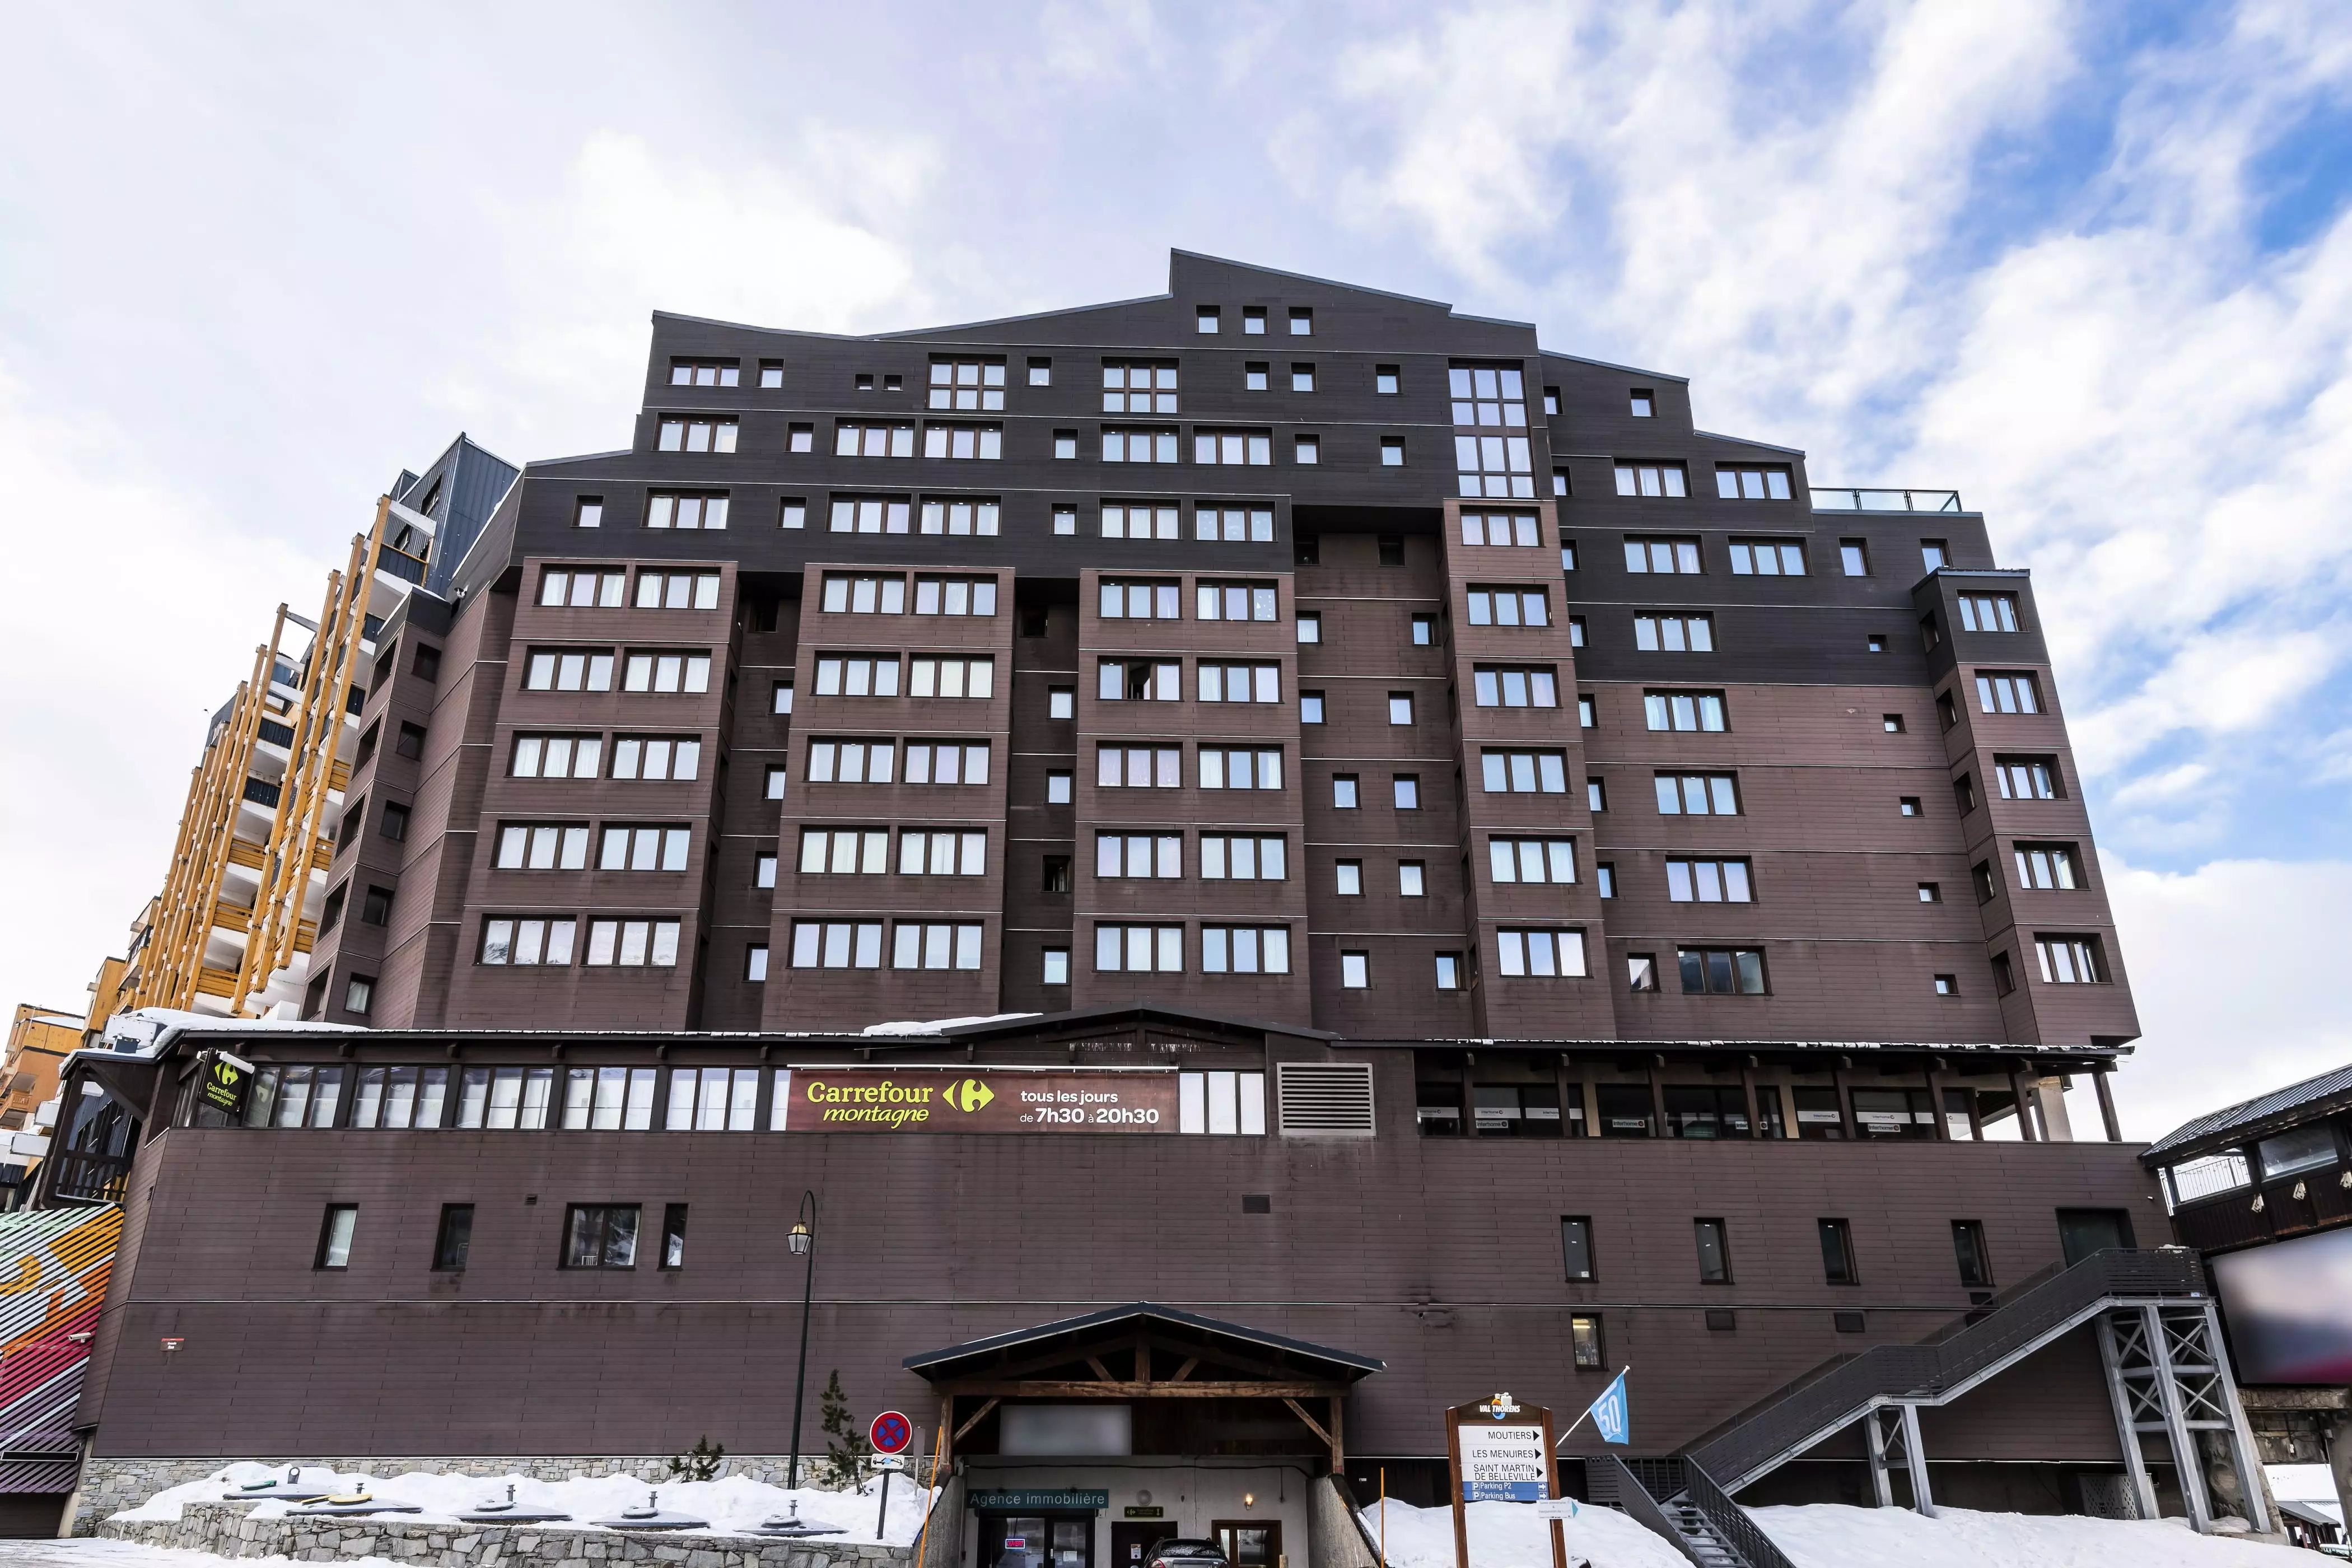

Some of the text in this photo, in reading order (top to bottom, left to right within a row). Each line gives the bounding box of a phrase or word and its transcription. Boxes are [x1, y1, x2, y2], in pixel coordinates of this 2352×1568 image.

[207, 1082, 237, 1100] Carrefour
[207, 1092, 233, 1106] montagne
[807, 1081, 934, 1103] Carrefour
[1020, 1090, 1118, 1105] tous les jours
[823, 1105, 929, 1129] montagne
[1020, 1107, 1159, 1124] de 7h30 à 20h30
[1598, 1395, 1621, 1433] 50
[970, 1492, 1105, 1507] Agence immobilière
